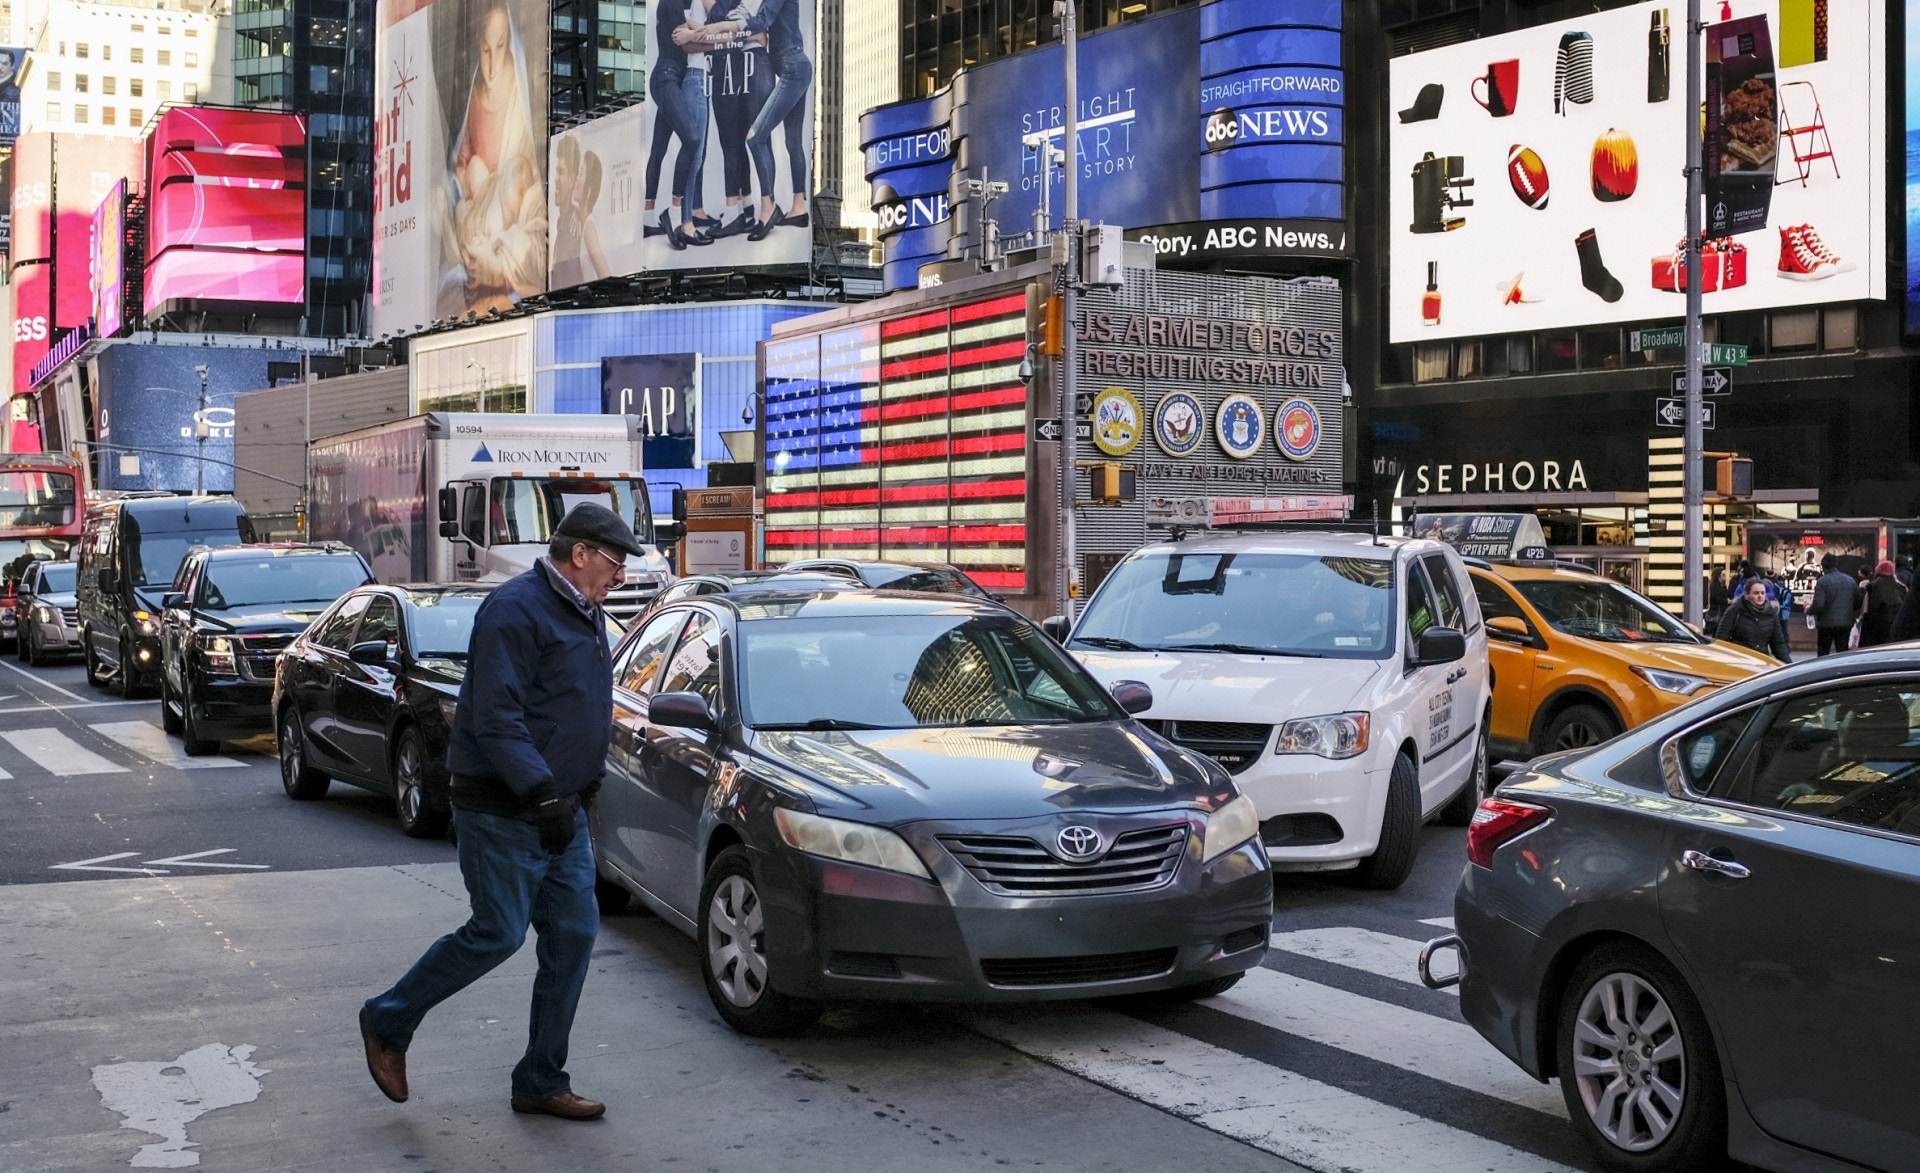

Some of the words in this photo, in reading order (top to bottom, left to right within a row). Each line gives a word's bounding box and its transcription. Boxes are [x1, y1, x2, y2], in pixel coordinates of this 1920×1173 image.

[706, 31, 733, 41] meet
[736, 30, 752, 38] me
[714, 42, 723, 50] in
[726, 41, 743, 49] the
[703, 51, 755, 97] GAP
[1201, 76, 1340, 103] STRAIGHTFORWARD
[1022, 88, 1135, 133] STRIGHT
[1205, 118, 1238, 143] abc
[1239, 110, 1329, 139] NEWS
[1021, 175, 1040, 191] OF
[1085, 155, 1136, 179] STORY
[390, 223, 398, 237] 25
[399, 216, 416, 233] DAYS
[1203, 227, 1257, 250] ABC
[1265, 226, 1334, 249] News.
[1124, 314, 1229, 350] ARMED
[1231, 322, 1335, 359] FORCES
[1642, 331, 1684, 348] Broadway
[1713, 345, 1721, 362] W
[1725, 347, 1736, 363] 43
[1740, 348, 1746, 358] St
[1084, 350, 1227, 382] RECRUITING
[1233, 358, 1326, 388] STATION
[1705, 376, 1722, 387] WAY
[1665, 408, 1682, 417] ONE
[180, 427, 223, 438] OKL
[456, 425, 483, 434] 10594
[1043, 425, 1060, 435] ONE
[1076, 426, 1087, 435] AY
[498, 450, 531, 463] IRON
[534, 450, 608, 463] MOUNTAIN
[1191, 465, 1214, 479] AIR
[1217, 466, 1260, 481] FORCE
[1272, 467, 1327, 483] MARINES
[1417, 460, 1588, 493] SEPHORA
[1476, 516, 1496, 533] NBA
[1493, 517, 1515, 533] Store
[1526, 547, 1545, 559] 4P29
